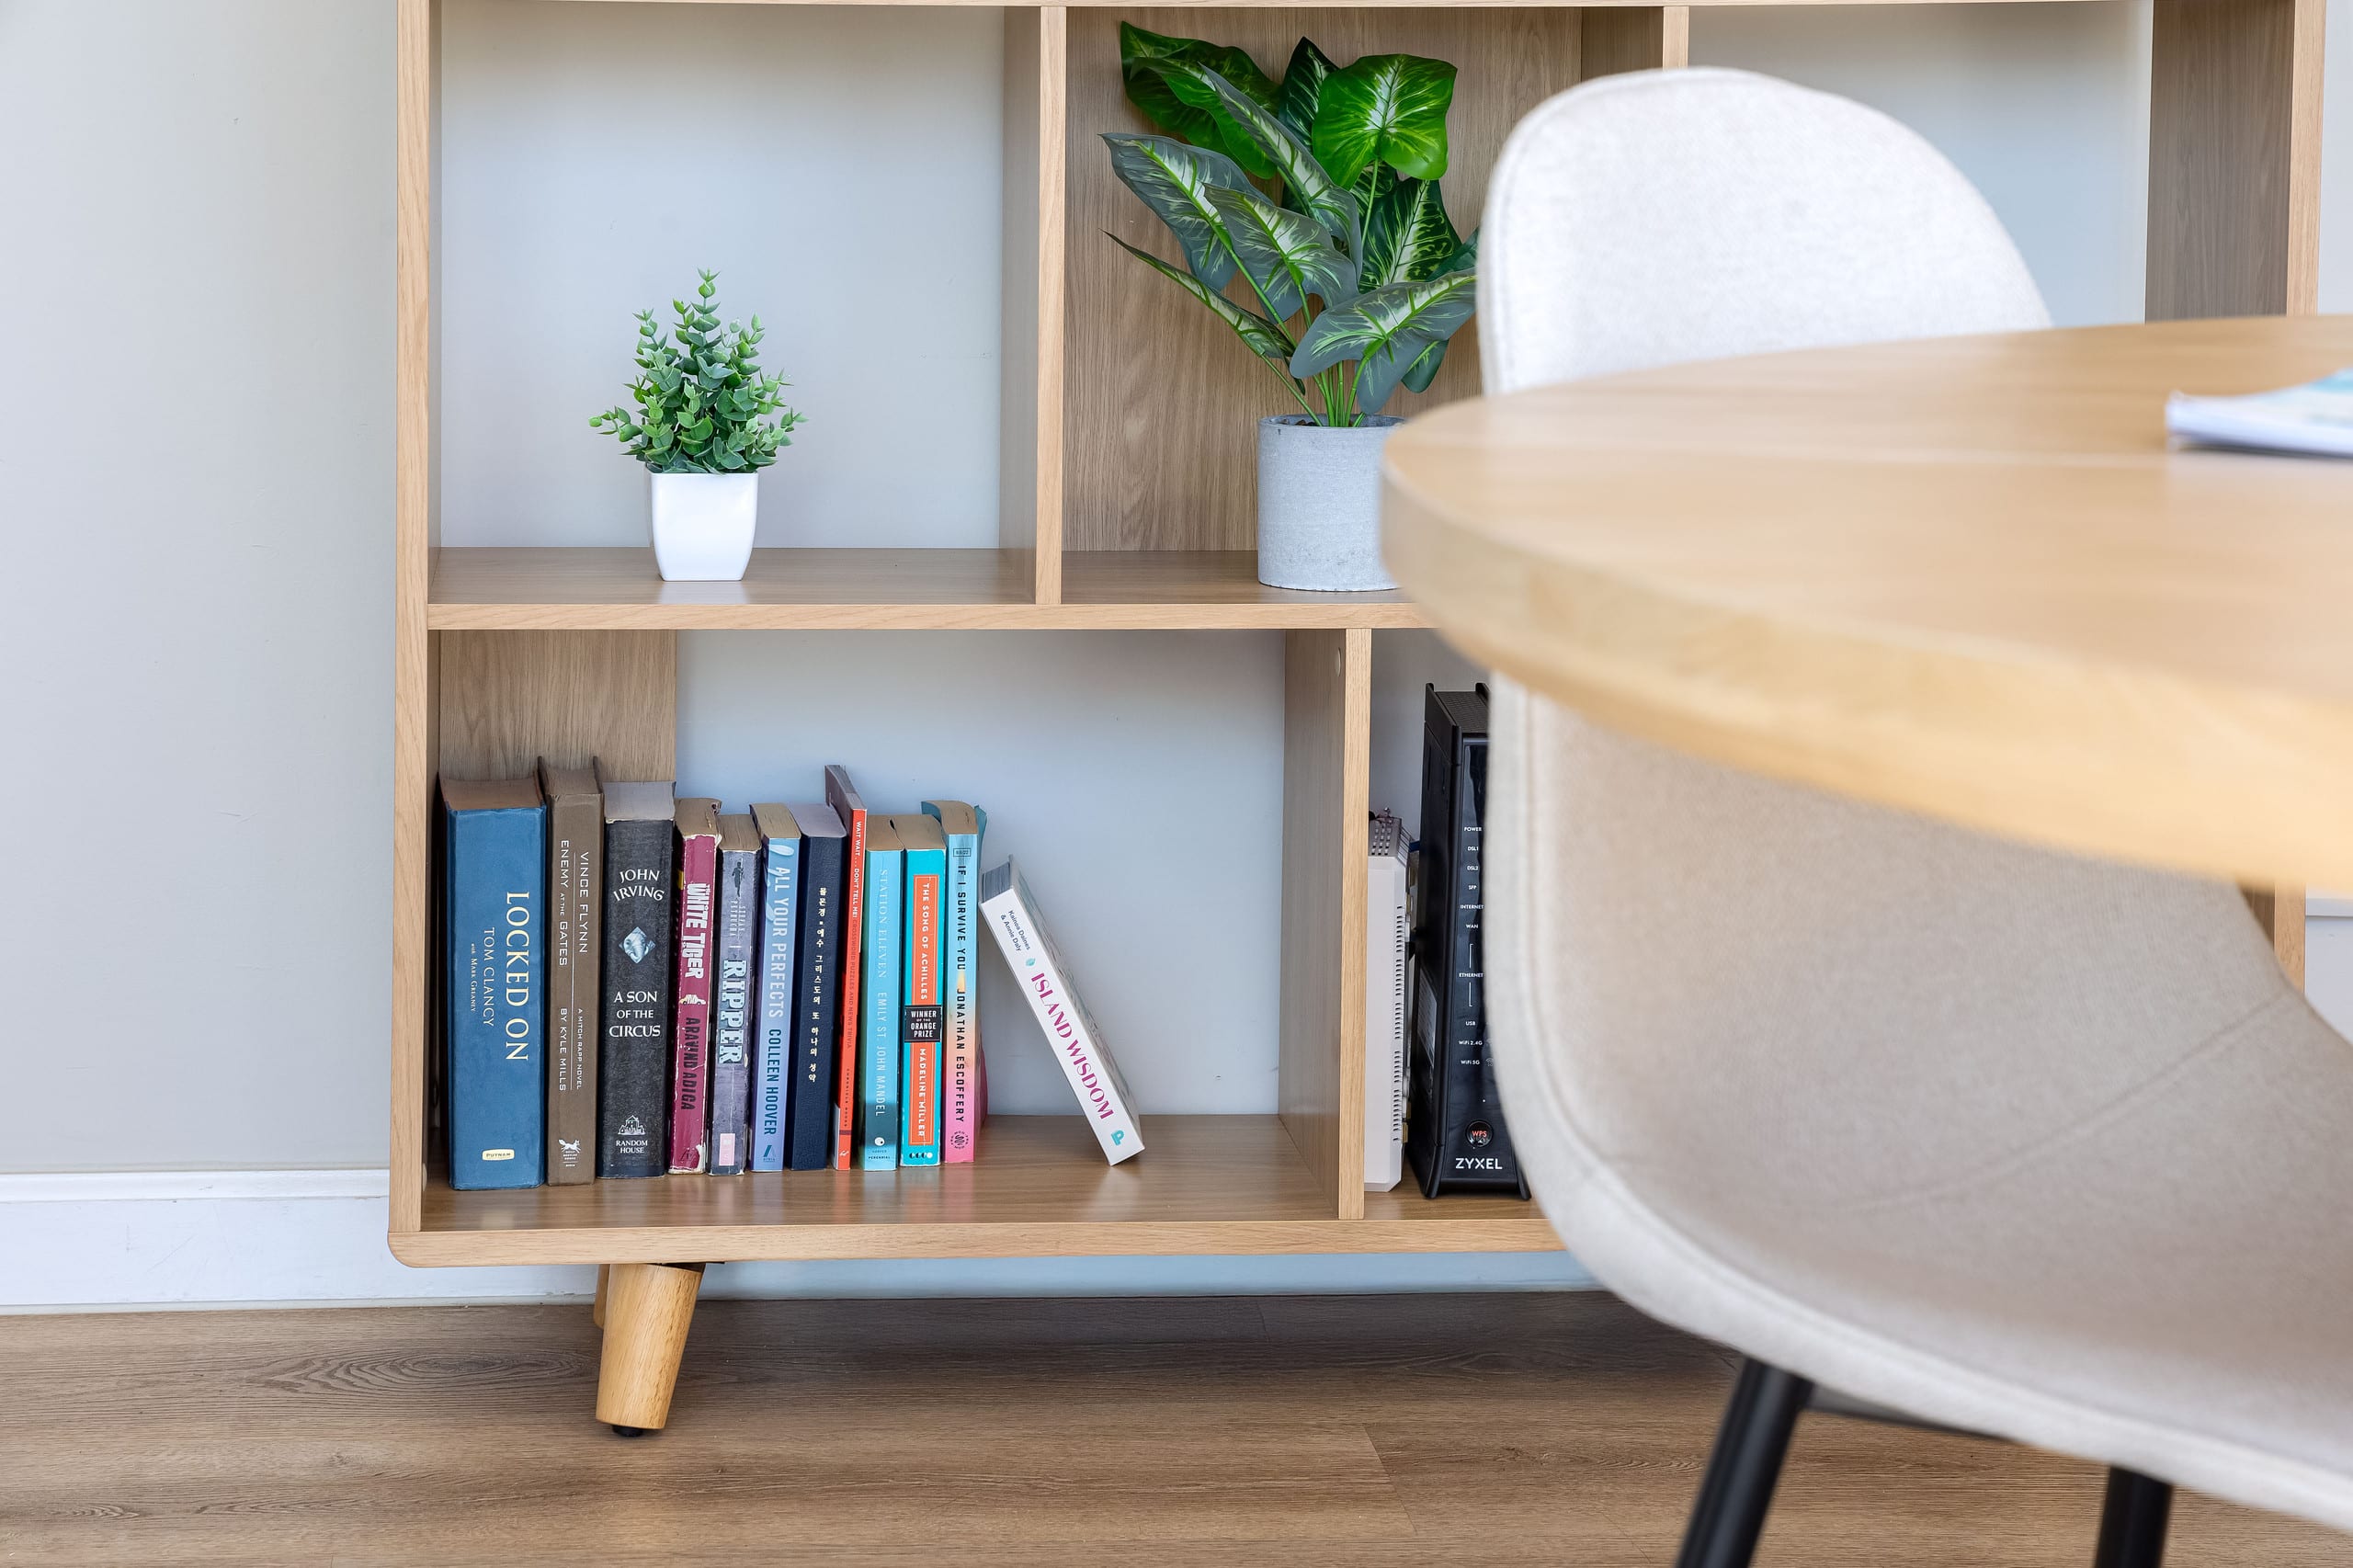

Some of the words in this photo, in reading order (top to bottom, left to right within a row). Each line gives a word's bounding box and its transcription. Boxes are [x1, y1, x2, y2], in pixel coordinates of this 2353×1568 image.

[561, 840, 570, 888] ENEMY
[580, 851, 588, 897] VINCE
[620, 869, 660, 884] JOHN
[774, 867, 790, 892] ALL
[958, 866, 967, 875] IF
[613, 885, 665, 902] IRVING
[686, 883, 710, 928] WHITE
[879, 869, 888, 925] STATION
[579, 904, 588, 952] FLYNN
[772, 898, 789, 937] YOUR
[958, 892, 967, 941] SURVIVE
[1004, 921, 1015, 937] Annie
[1013, 937, 1022, 951] Daly
[1008, 910, 1020, 930] Kainoa
[483, 926, 494, 961] TOM
[506, 892, 529, 1006] LOCKED
[559, 921, 568, 966] GATES
[682, 932, 706, 978] TIGER
[879, 928, 888, 978] ELEVEN
[921, 936, 928, 949] OF
[957, 949, 966, 971] YOU
[483, 967, 494, 1027] CLANCY
[613, 991, 623, 1003] A
[627, 991, 658, 1003] SON
[768, 943, 787, 1018] PERFECTS
[560, 1008, 567, 1022] BY
[616, 1009, 631, 1018] OF
[632, 1009, 654, 1018] THE
[719, 960, 747, 1064] RIPPER
[877, 993, 887, 1023] EMILY
[956, 989, 966, 1050] JONATHAN
[506, 1018, 529, 1061] ON
[559, 1027, 567, 1054] KYLE
[608, 1025, 661, 1038] CIRCUS
[684, 1017, 700, 1068] ARAVIND
[1030, 972, 1074, 1039] ISLAND
[1066, 1039, 1115, 1119] WISDOM
[767, 1029, 781, 1082] COLLEEN
[876, 1046, 886, 1072] JOHN
[681, 1072, 697, 1110] ADIGA
[875, 1075, 886, 1117] MANDEL
[956, 1055, 965, 1122] ESCOFFERY
[764, 1087, 779, 1135] HOOVER
[1455, 1158, 1503, 1170] ZYXEL
